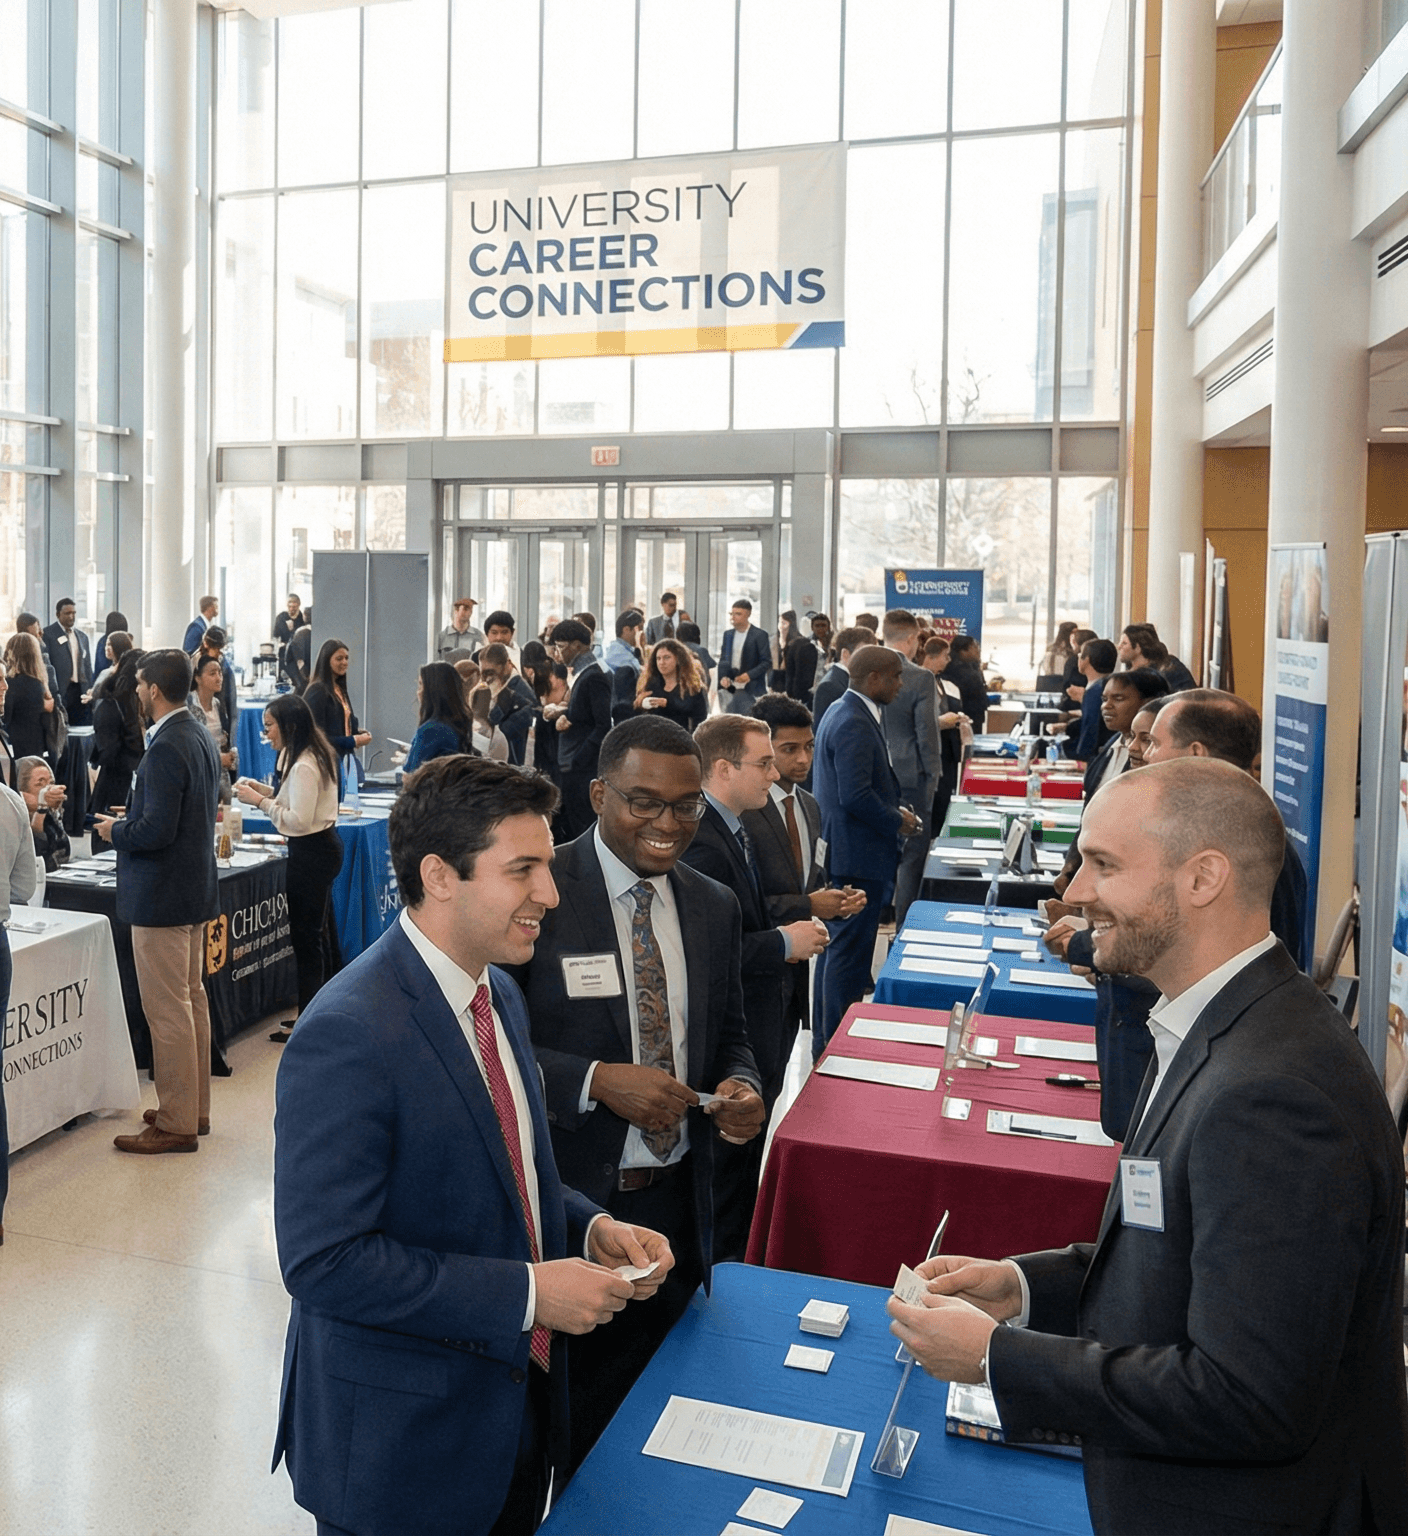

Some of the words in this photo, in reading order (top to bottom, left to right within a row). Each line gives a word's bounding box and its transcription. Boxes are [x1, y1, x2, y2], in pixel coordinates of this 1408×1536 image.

[470, 181, 748, 235] UNIVERSITY
[468, 233, 659, 277] CAREER
[467, 267, 827, 320] CONNECTIONS
[1, 977, 89, 1051] ERSITY
[2, 1031, 84, 1083] ONNECTIONS
